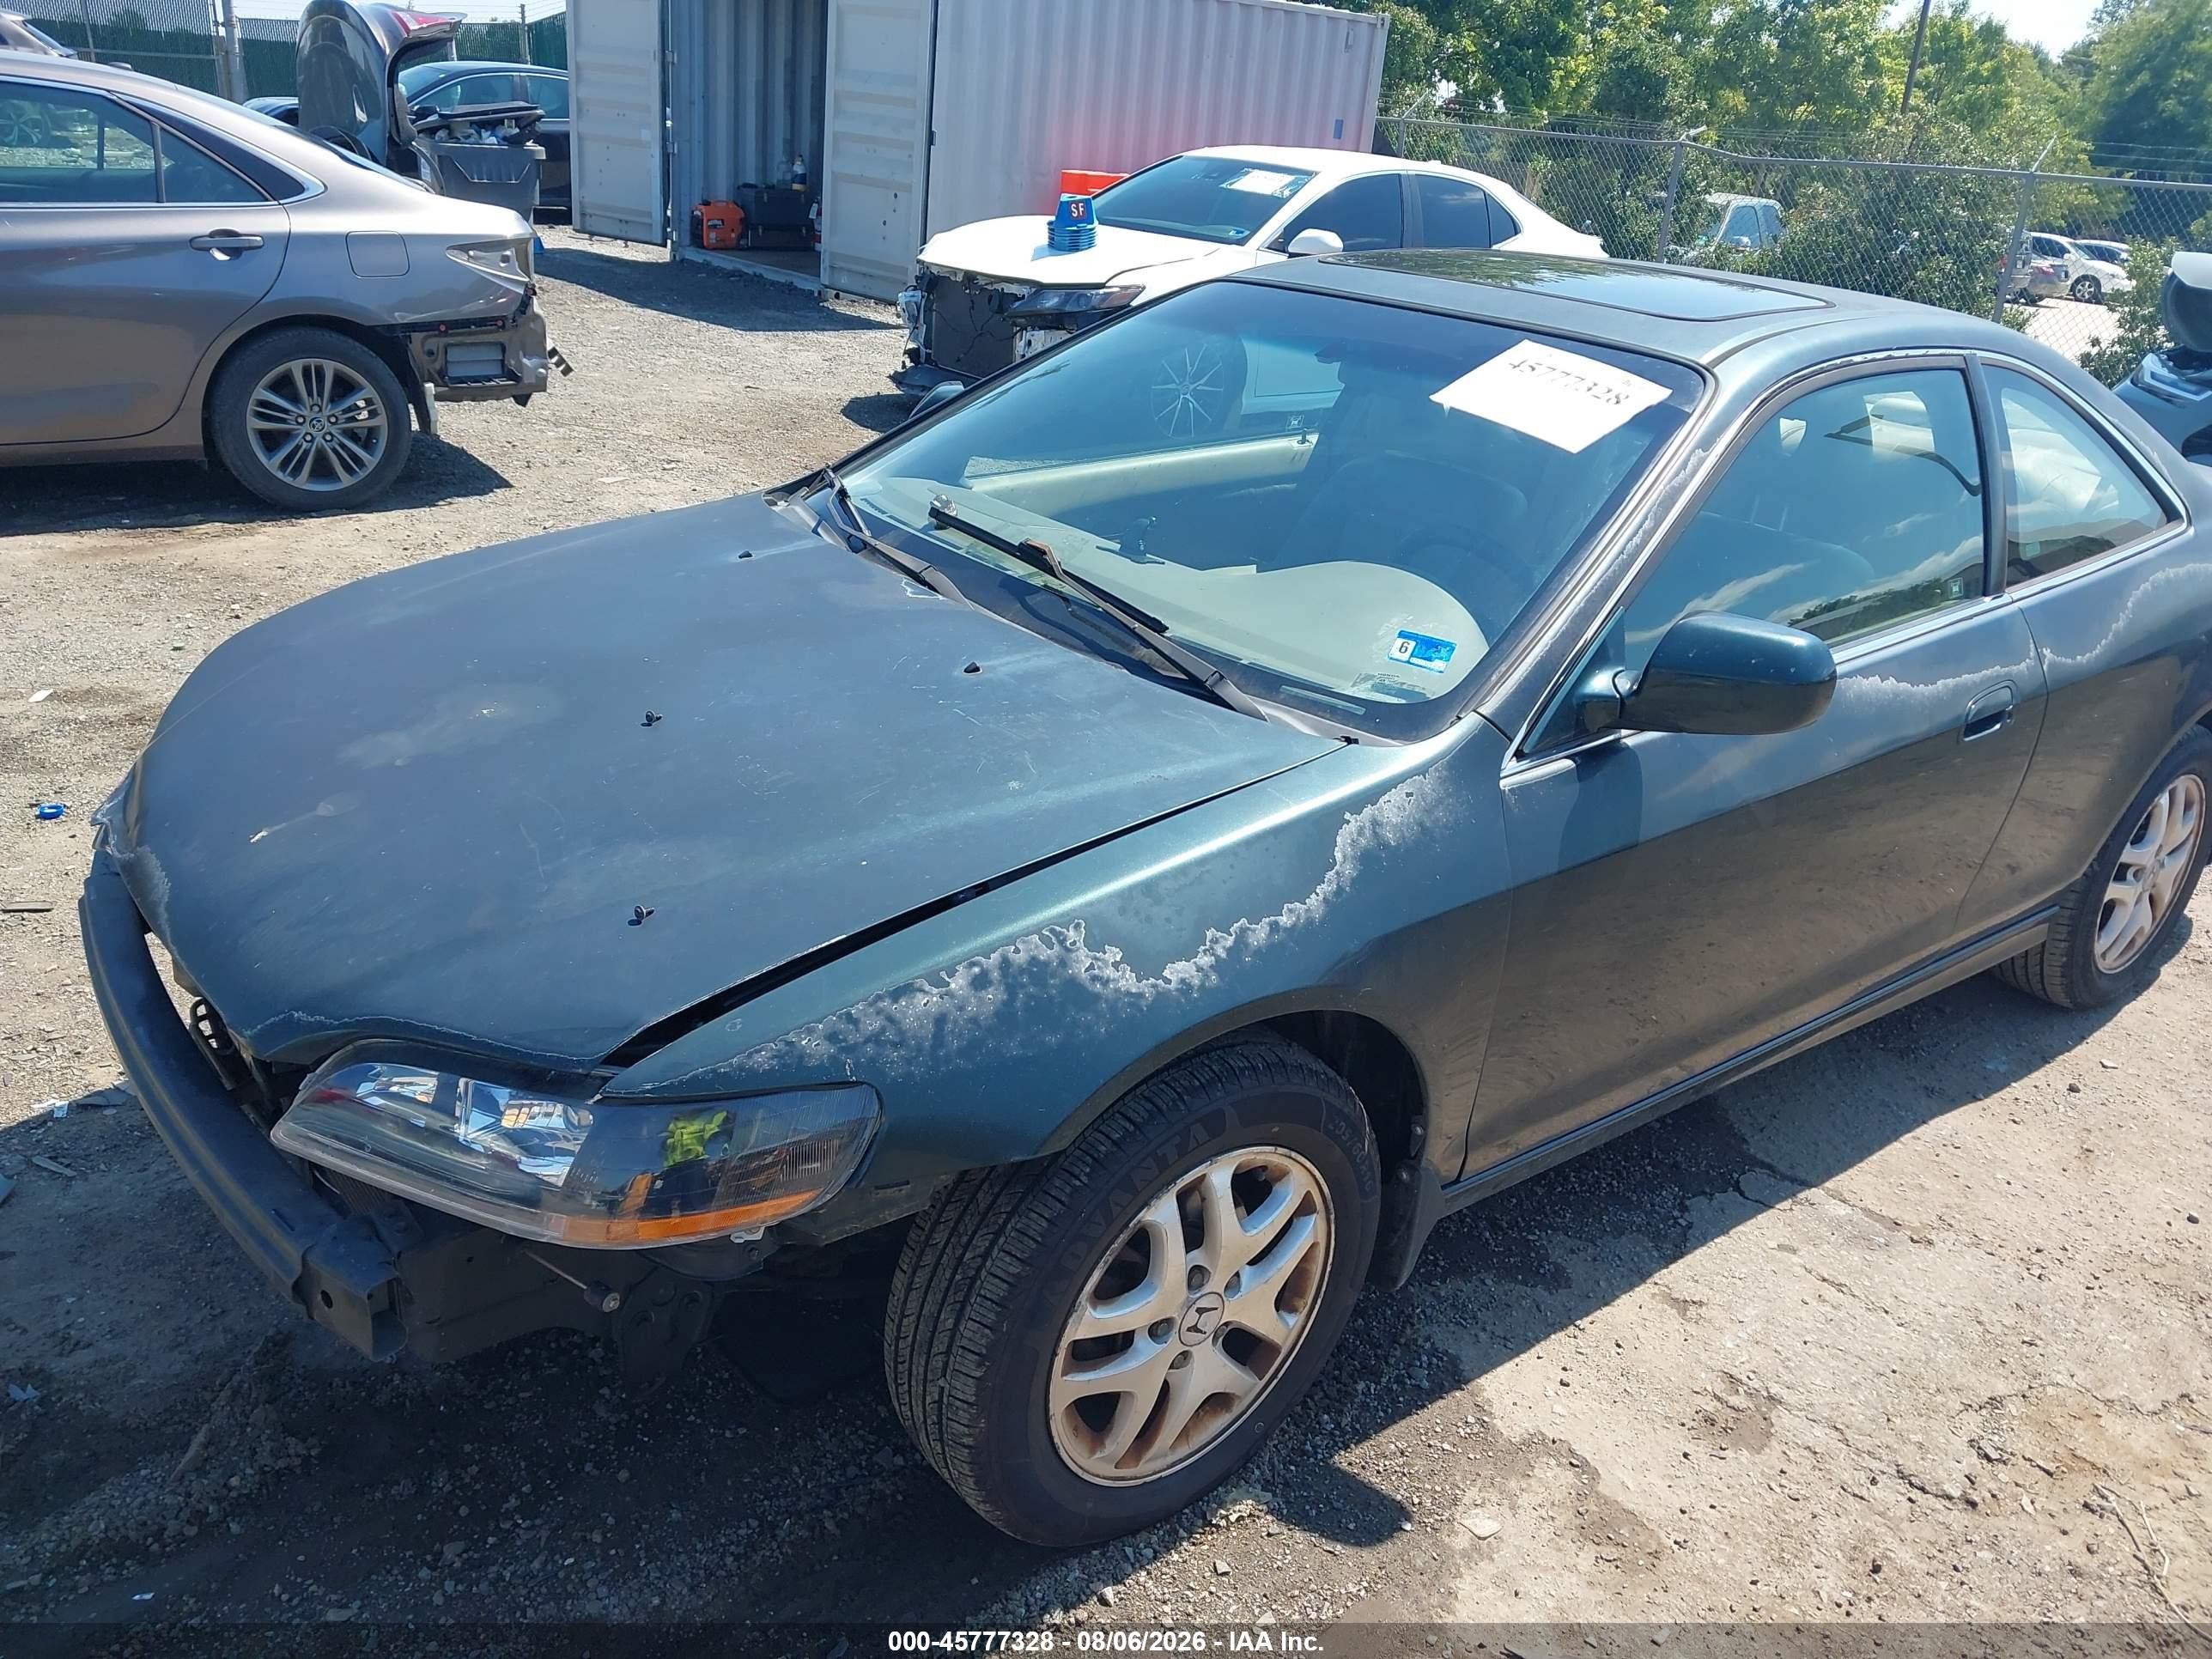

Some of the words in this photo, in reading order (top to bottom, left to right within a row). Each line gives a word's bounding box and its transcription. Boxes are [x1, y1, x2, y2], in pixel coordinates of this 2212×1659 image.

[1071, 203, 1085, 217] SF
[1509, 359, 1630, 405] 45777328
[1398, 641, 1410, 654] 6
